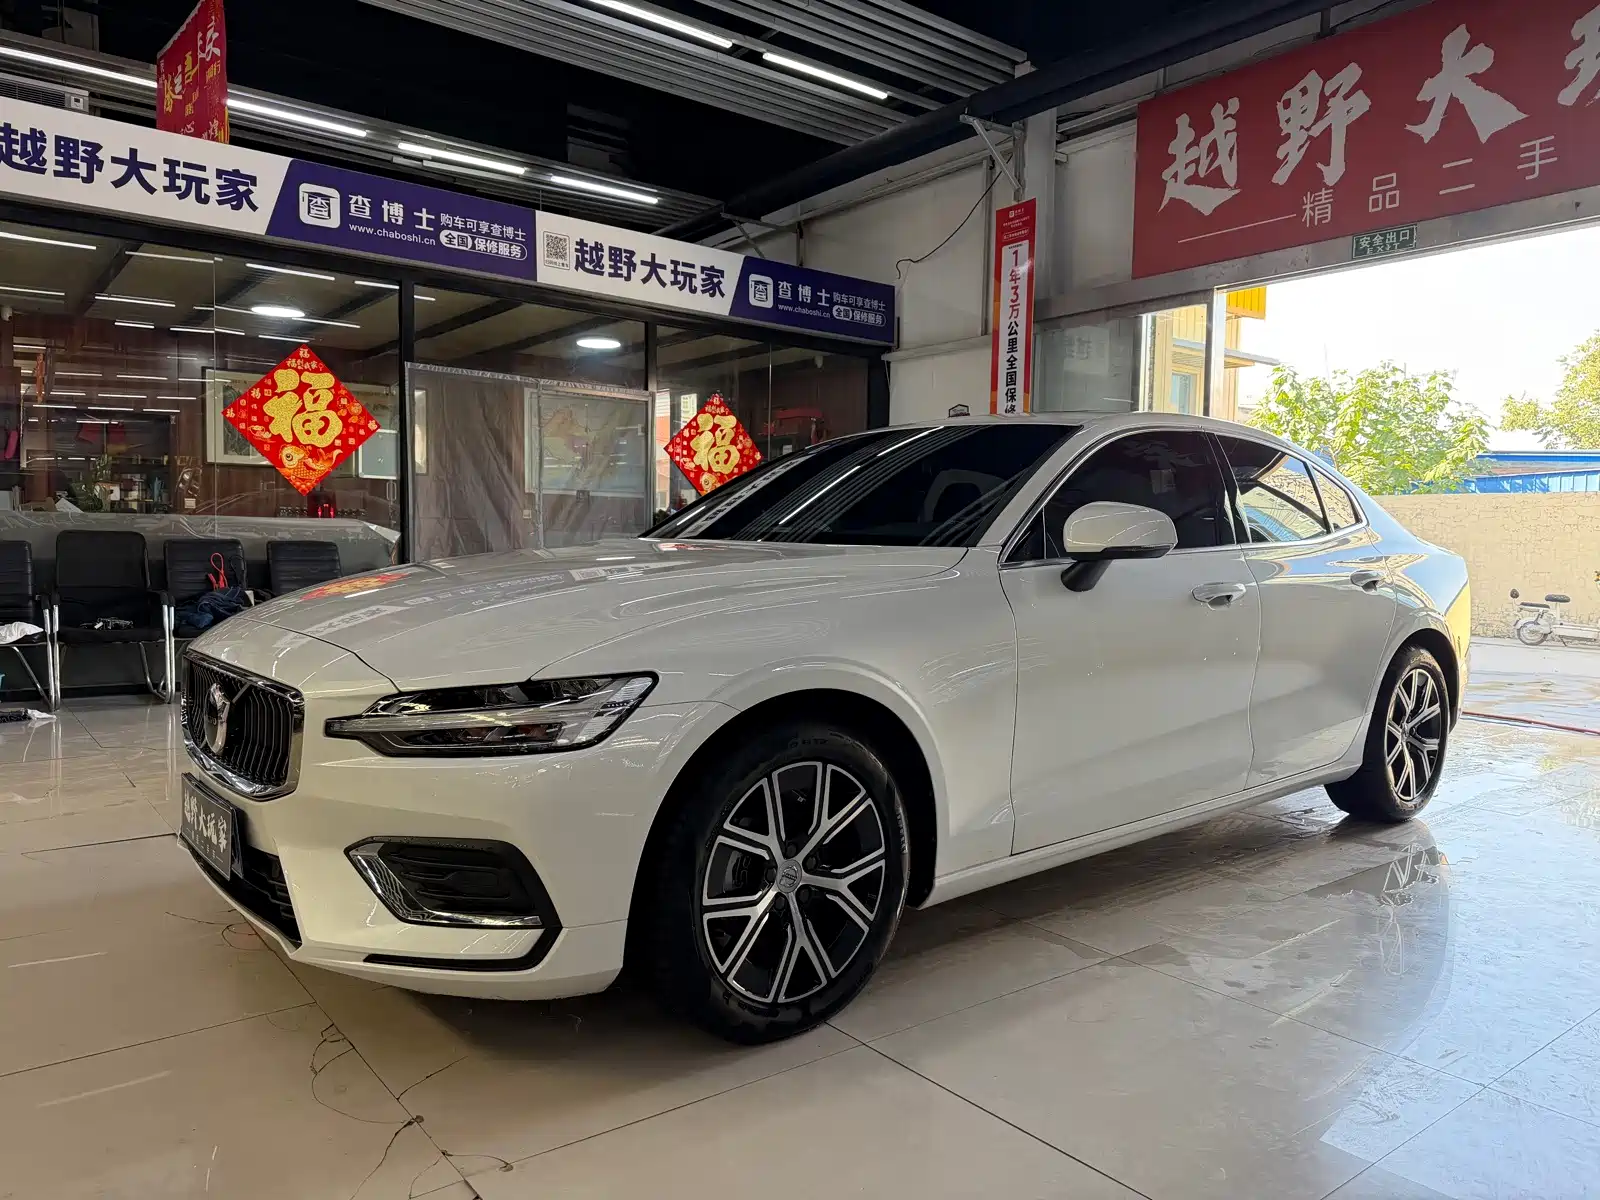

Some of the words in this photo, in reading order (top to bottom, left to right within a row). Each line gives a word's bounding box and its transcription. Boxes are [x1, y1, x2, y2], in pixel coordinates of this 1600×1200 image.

[0, 122, 259, 213] 越野大玩家
[1301, 135, 1558, 228] 精品二手
[348, 194, 435, 232] 查博士
[349, 223, 436, 247] www.chaboshi.cn
[440, 213, 527, 242] 购车可享查博士
[1359, 229, 1410, 249] 安全出口
[444, 232, 469, 250] 全国
[474, 238, 522, 258] 保修服务
[575, 238, 725, 298] 越野大玩家
[778, 281, 830, 307] 查博士
[832, 291, 886, 312] 购车可享查博士
[778, 304, 831, 318] www.chaboshi.cn
[835, 308, 850, 320] 全国
[853, 311, 883, 325] 保修服务
[262, 368, 343, 448] 福
[690, 413, 740, 475] 福
